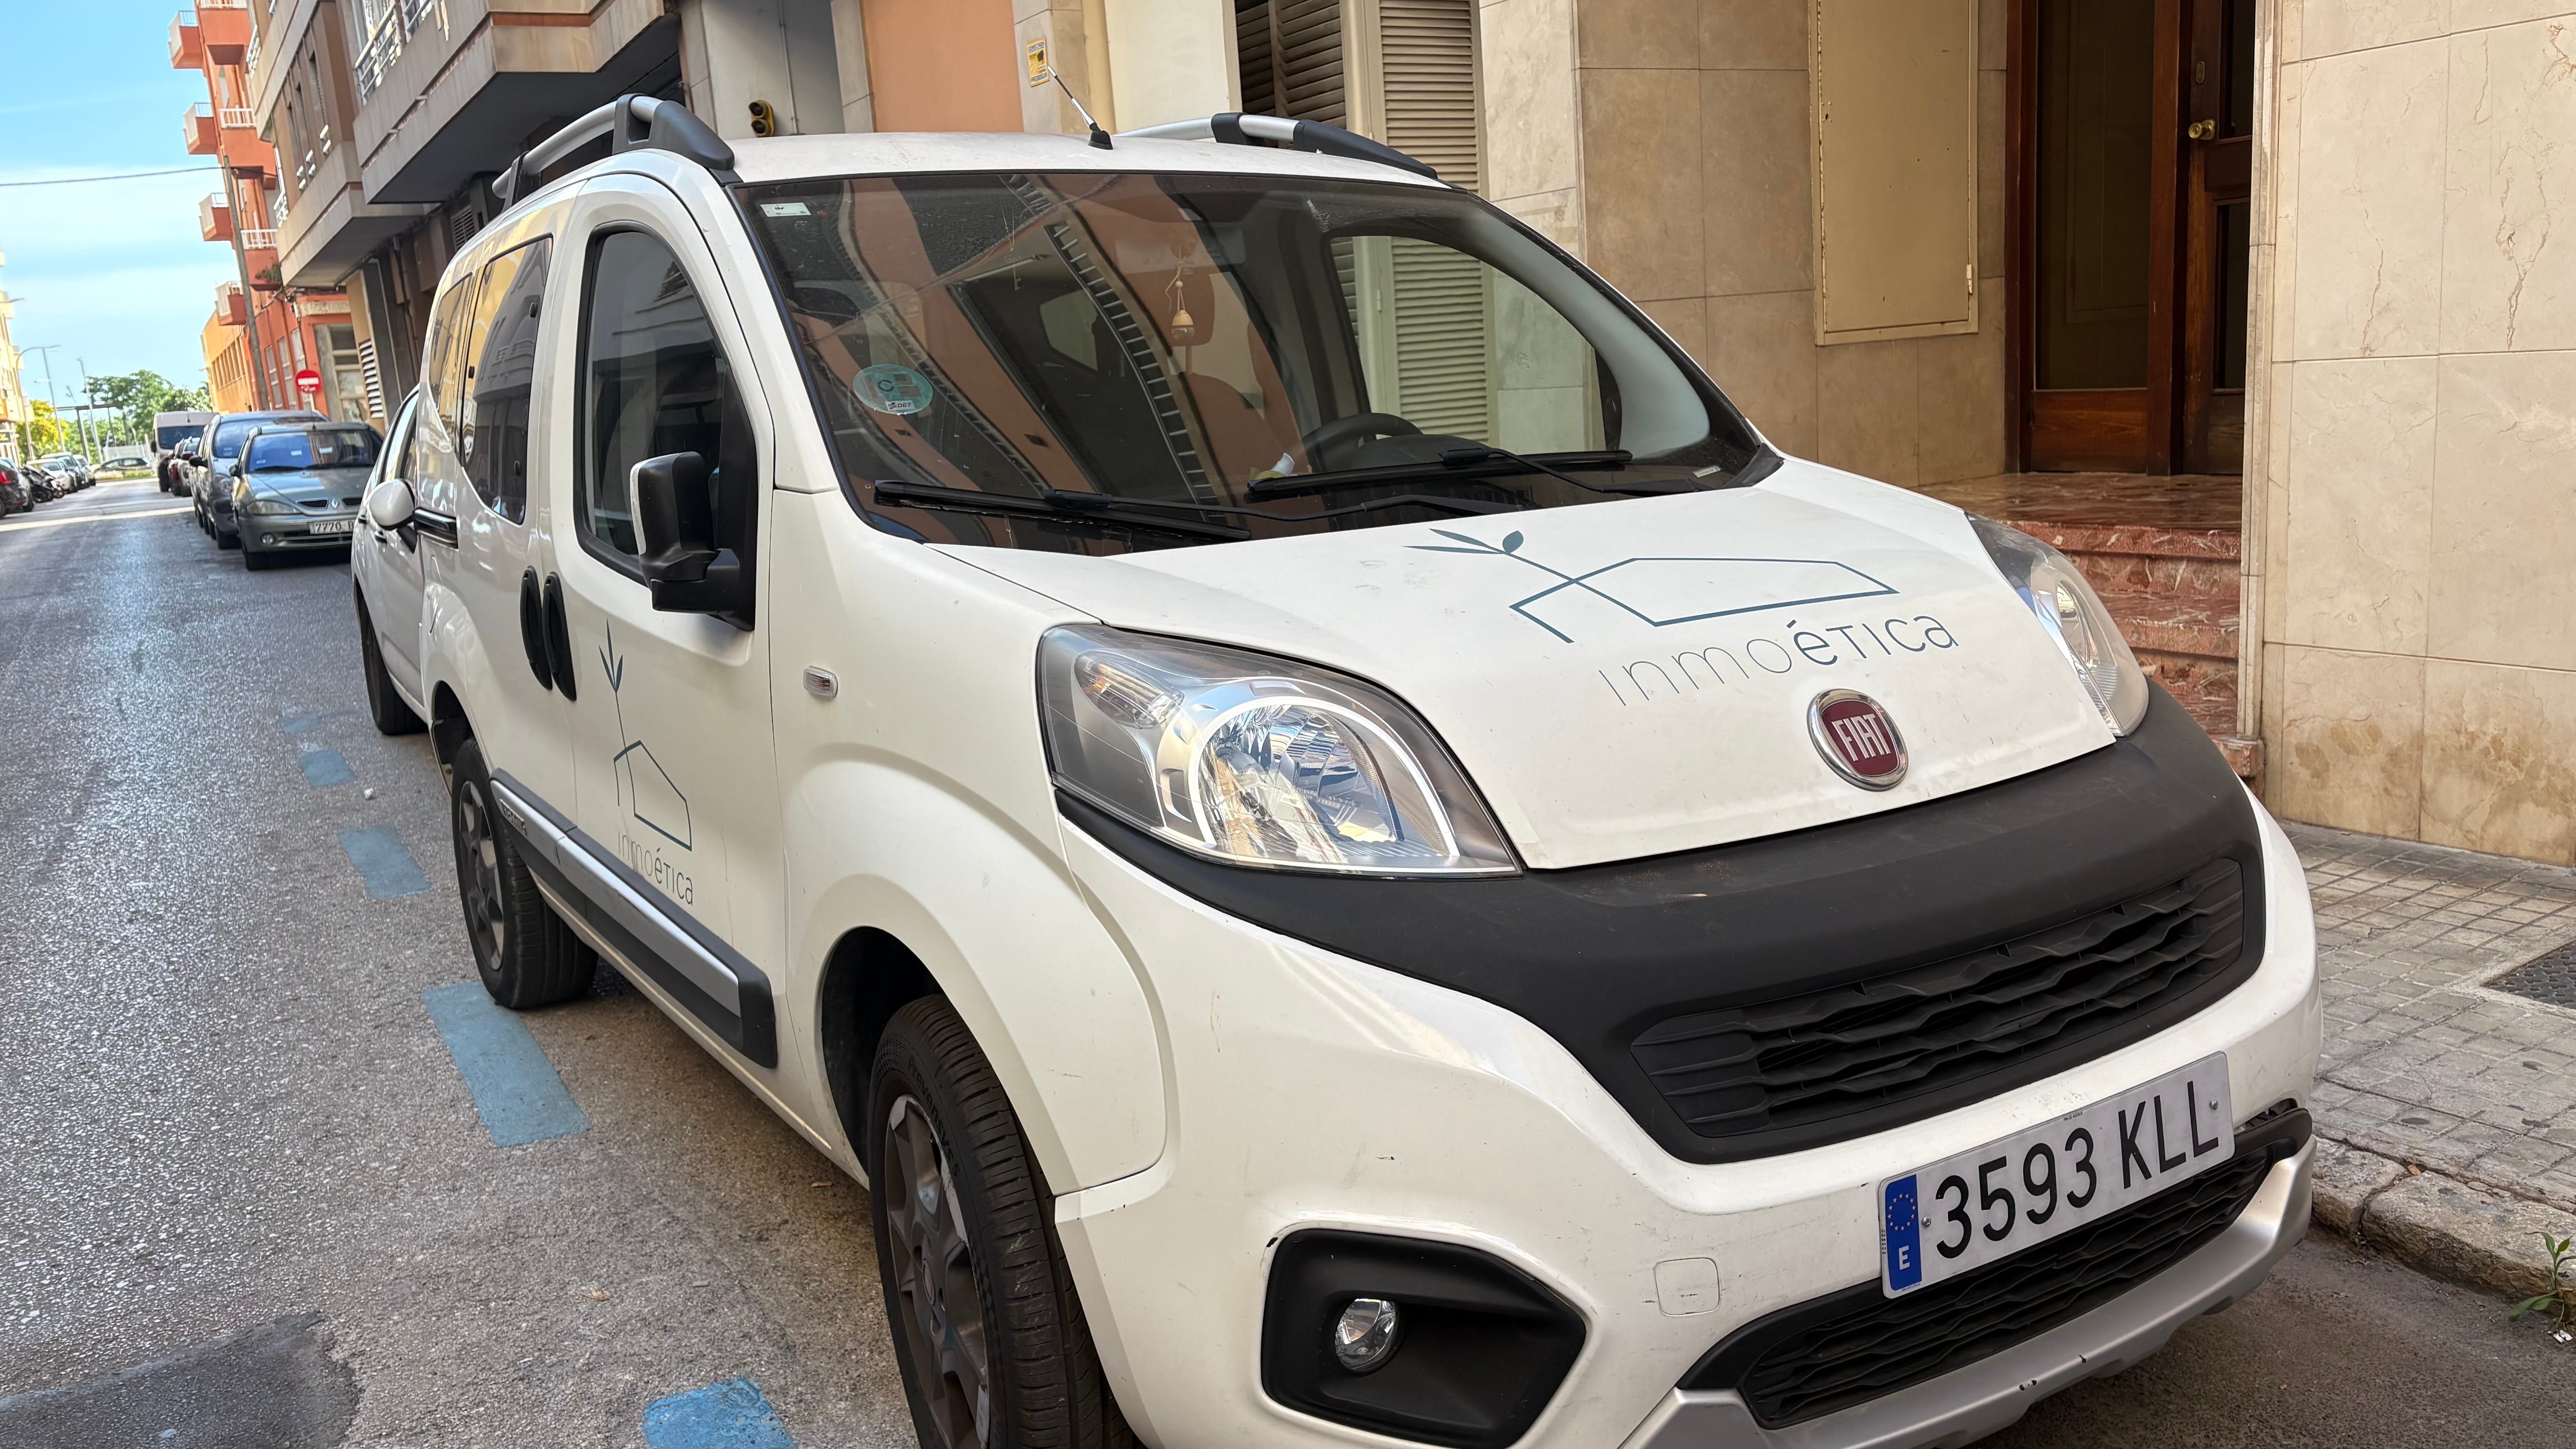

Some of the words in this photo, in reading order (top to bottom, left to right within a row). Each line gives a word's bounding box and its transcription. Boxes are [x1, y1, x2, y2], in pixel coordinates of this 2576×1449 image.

[878, 380, 894, 391] C
[1831, 713, 1891, 762] FIAT
[1935, 1127, 2097, 1259] 3593
[2118, 1081, 2219, 1190] KLL
[1899, 1245, 1910, 1270] E
